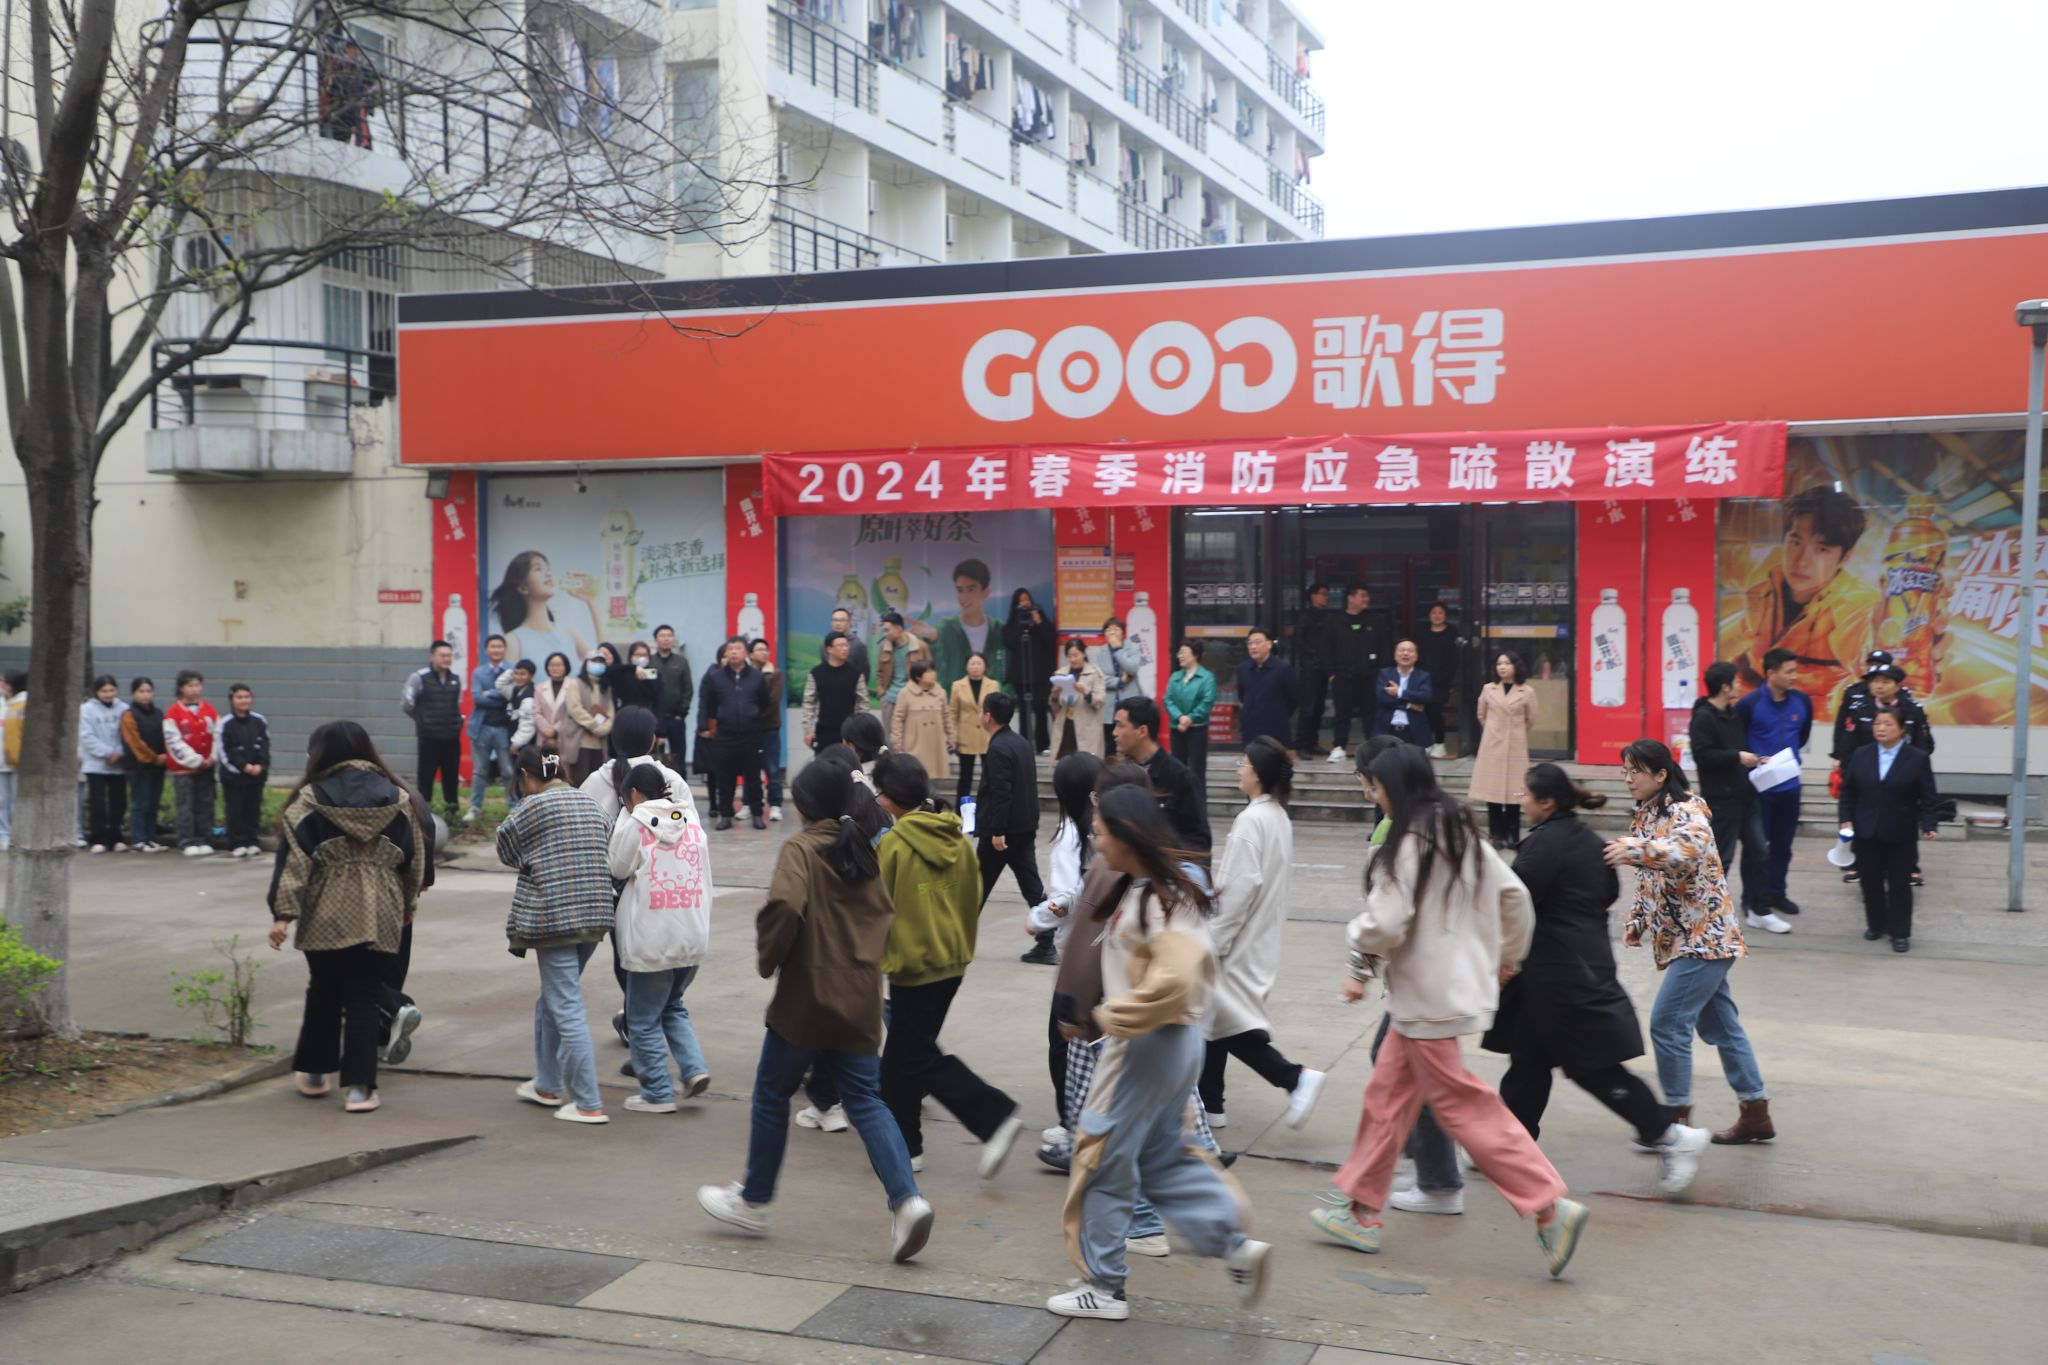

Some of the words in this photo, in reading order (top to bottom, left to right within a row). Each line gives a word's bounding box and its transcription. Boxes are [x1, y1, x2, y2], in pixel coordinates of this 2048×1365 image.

[961, 316, 1298, 422] GOOD
[1311, 308, 1506, 410] 歌得
[797, 435, 1739, 504] 2024年春季消防应急疏散演练
[649, 889, 703, 910] BEST
